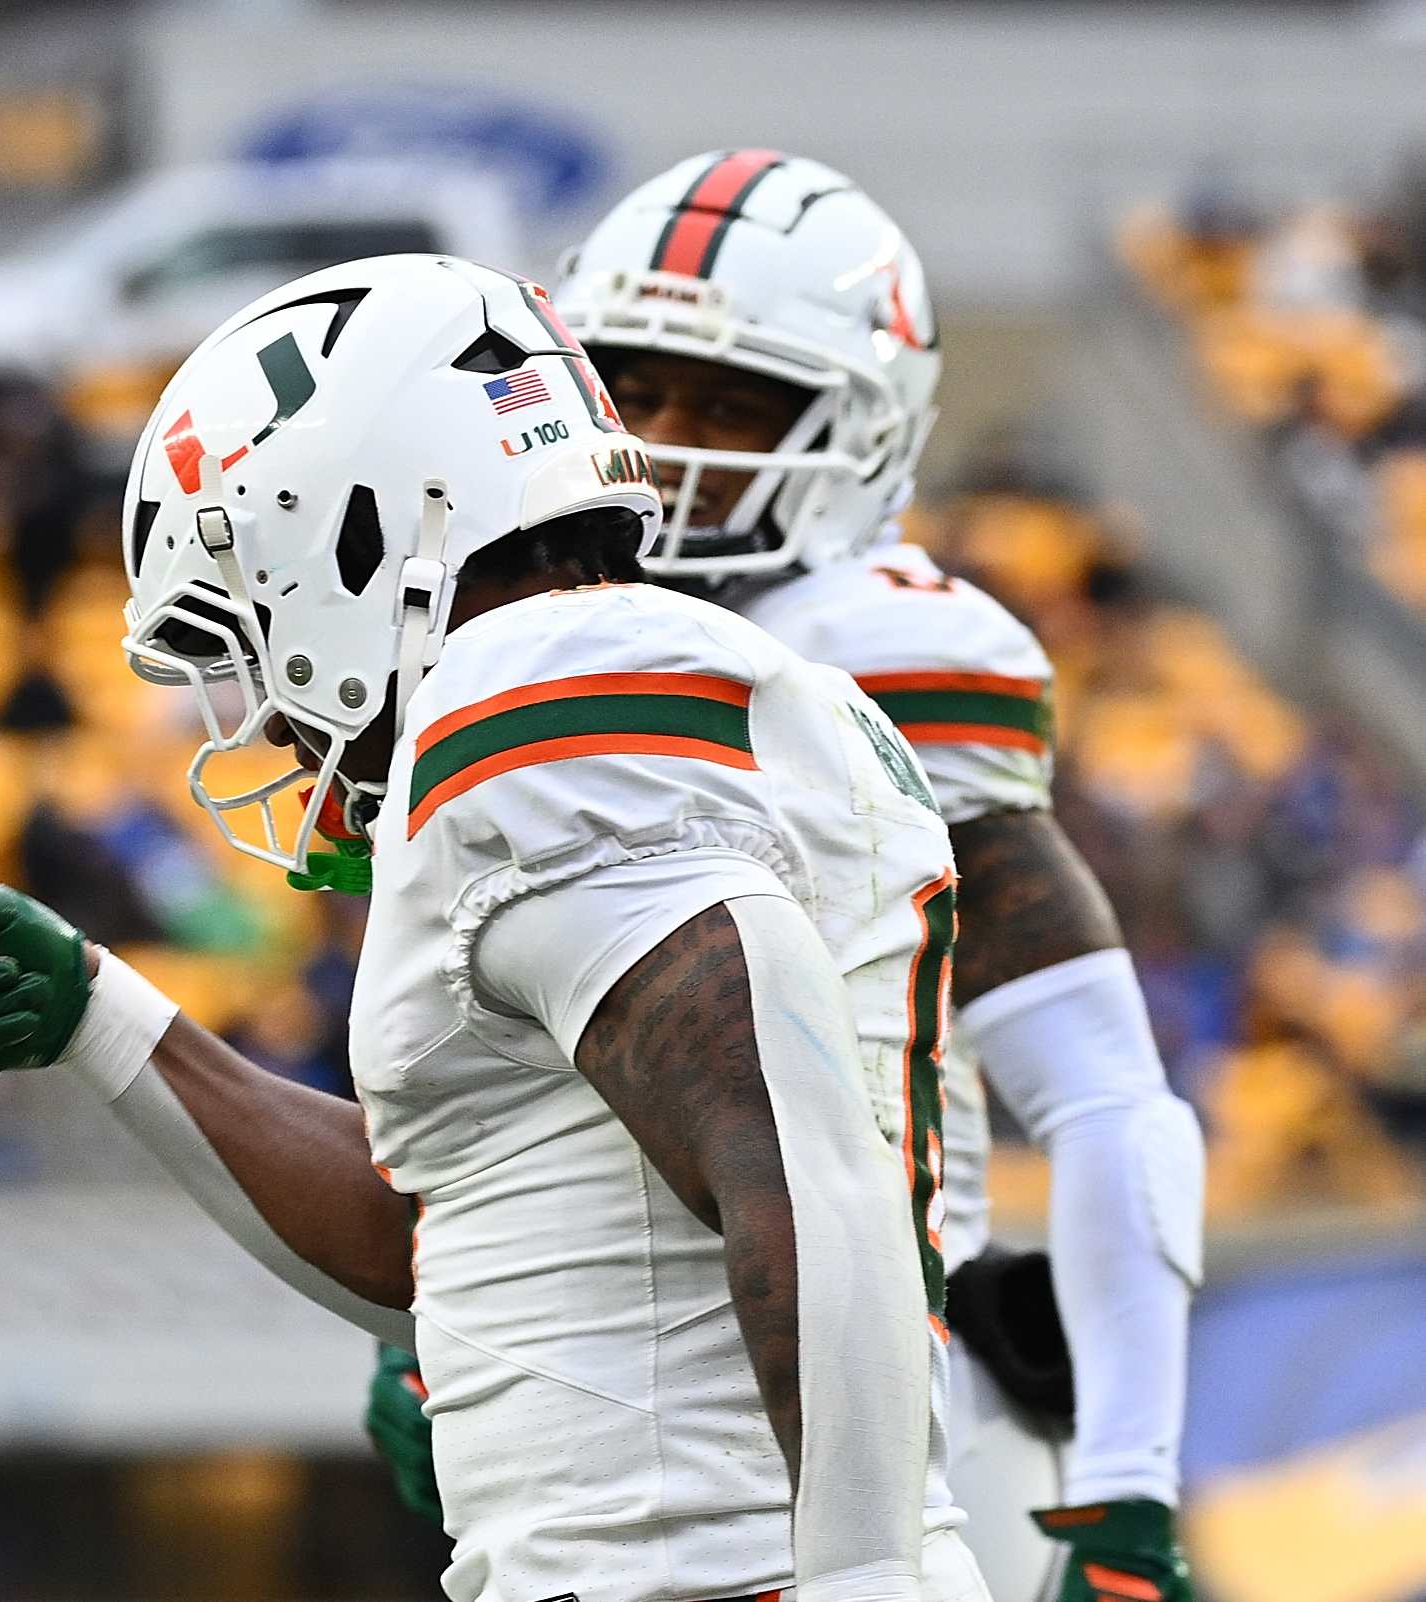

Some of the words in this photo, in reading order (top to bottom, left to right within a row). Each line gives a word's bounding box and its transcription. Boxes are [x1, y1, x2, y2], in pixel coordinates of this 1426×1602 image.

[500, 431, 533, 457] U
[534, 420, 570, 445] 100
[590, 448, 659, 488] MIA
